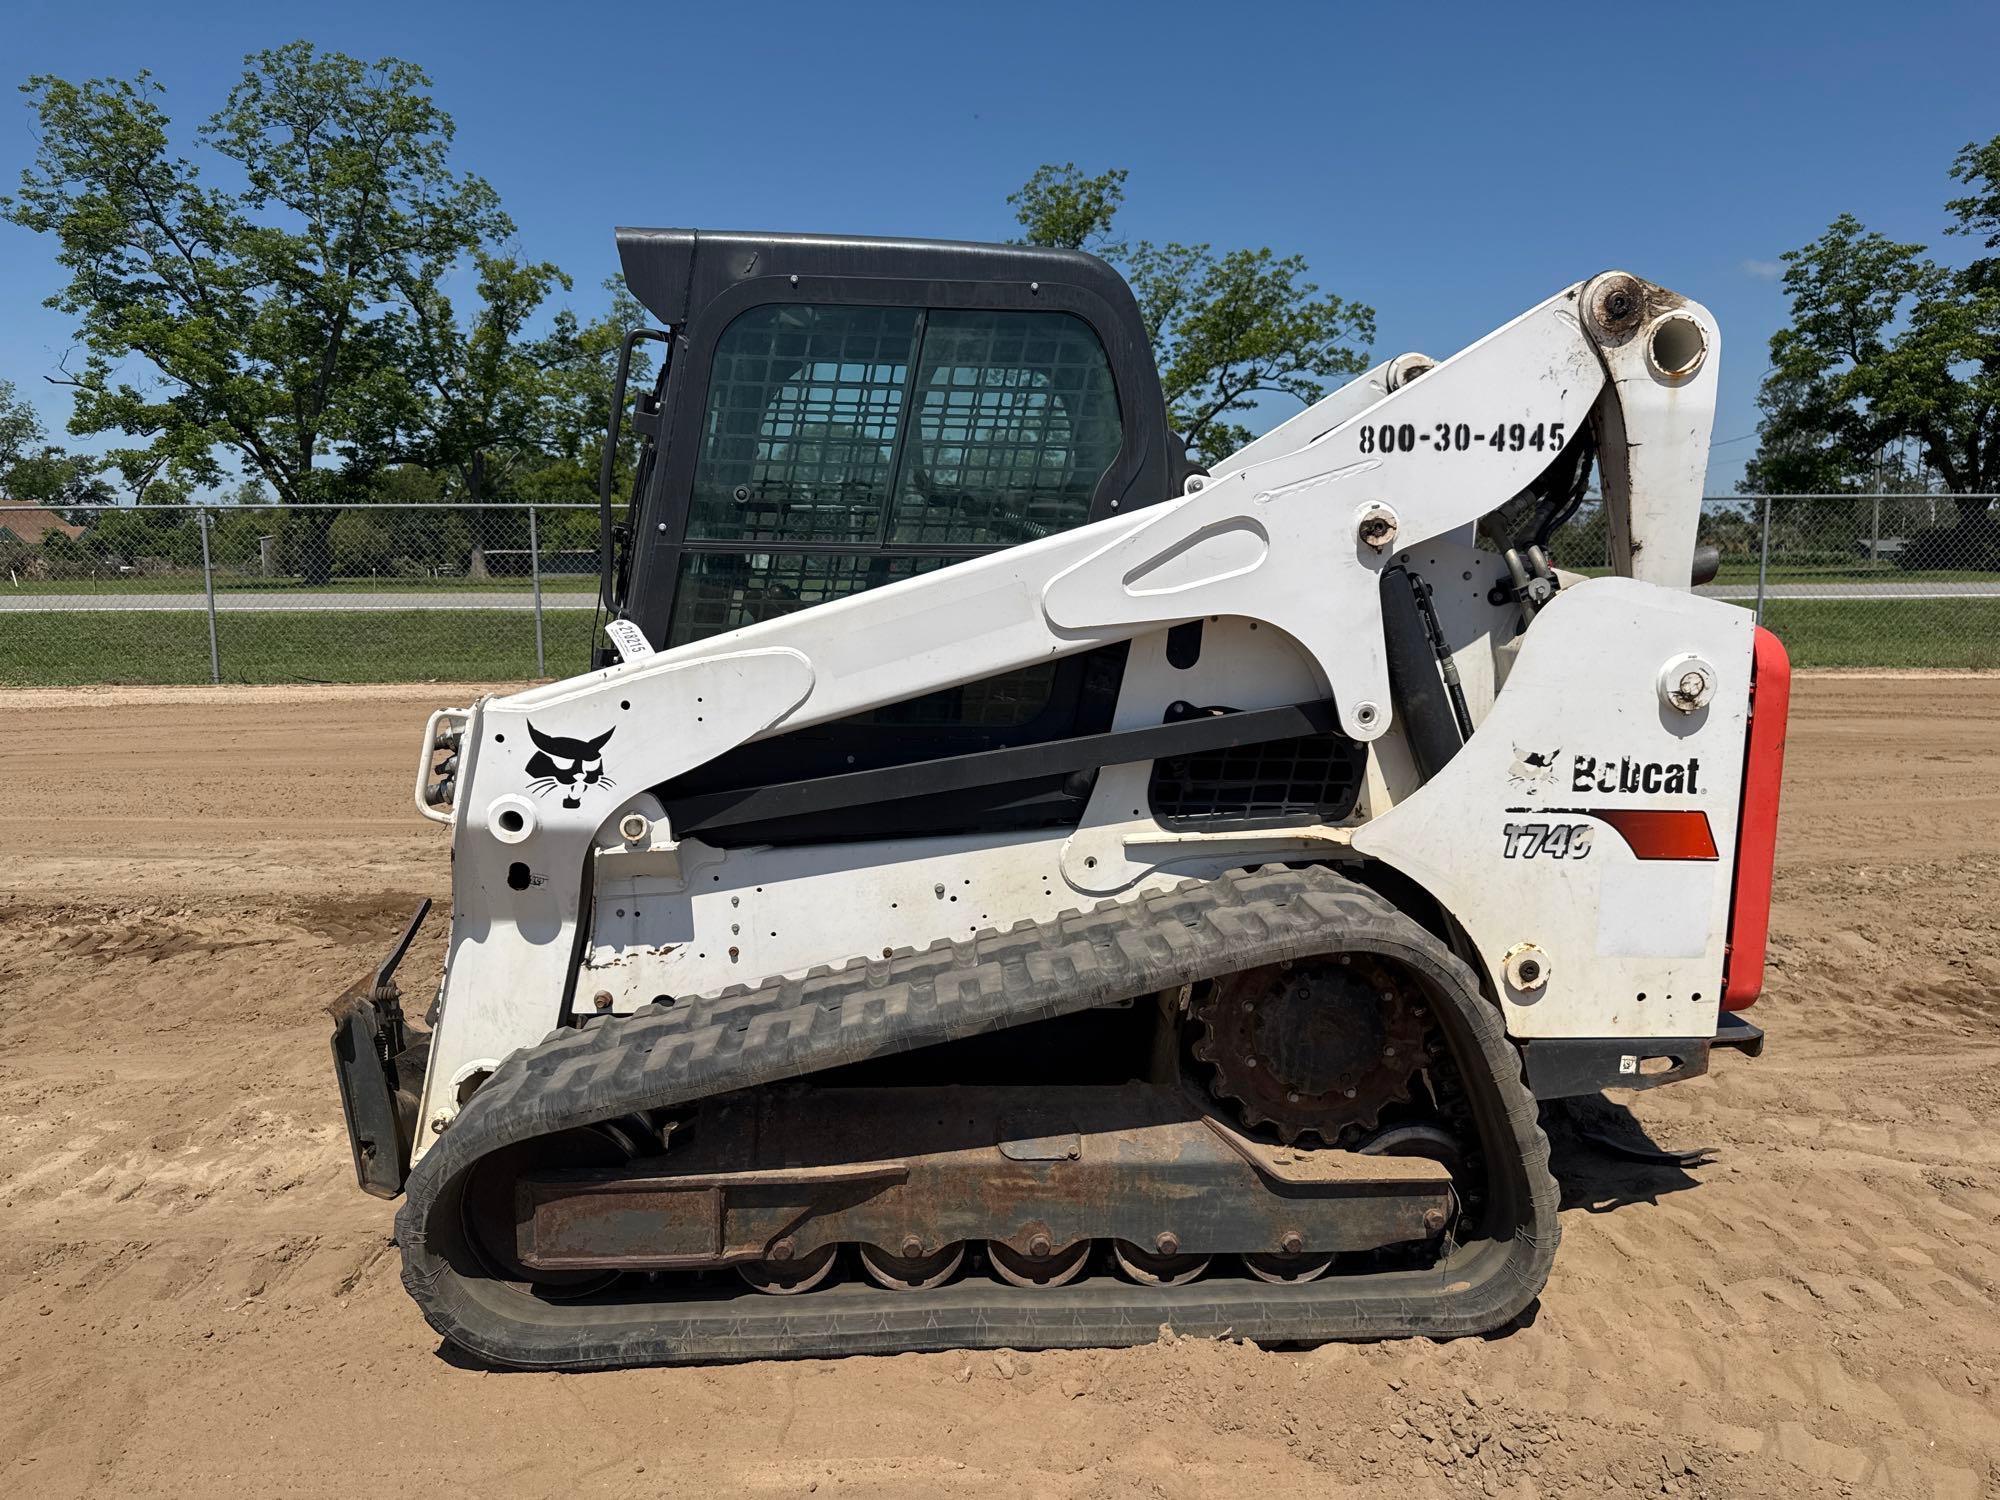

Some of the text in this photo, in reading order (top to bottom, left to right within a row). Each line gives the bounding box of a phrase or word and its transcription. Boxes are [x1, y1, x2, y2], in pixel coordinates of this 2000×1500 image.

[1359, 423, 1565, 454] 800-30-4945
[1572, 755, 1700, 794] Bobcat
[1503, 823, 1594, 860] T740
